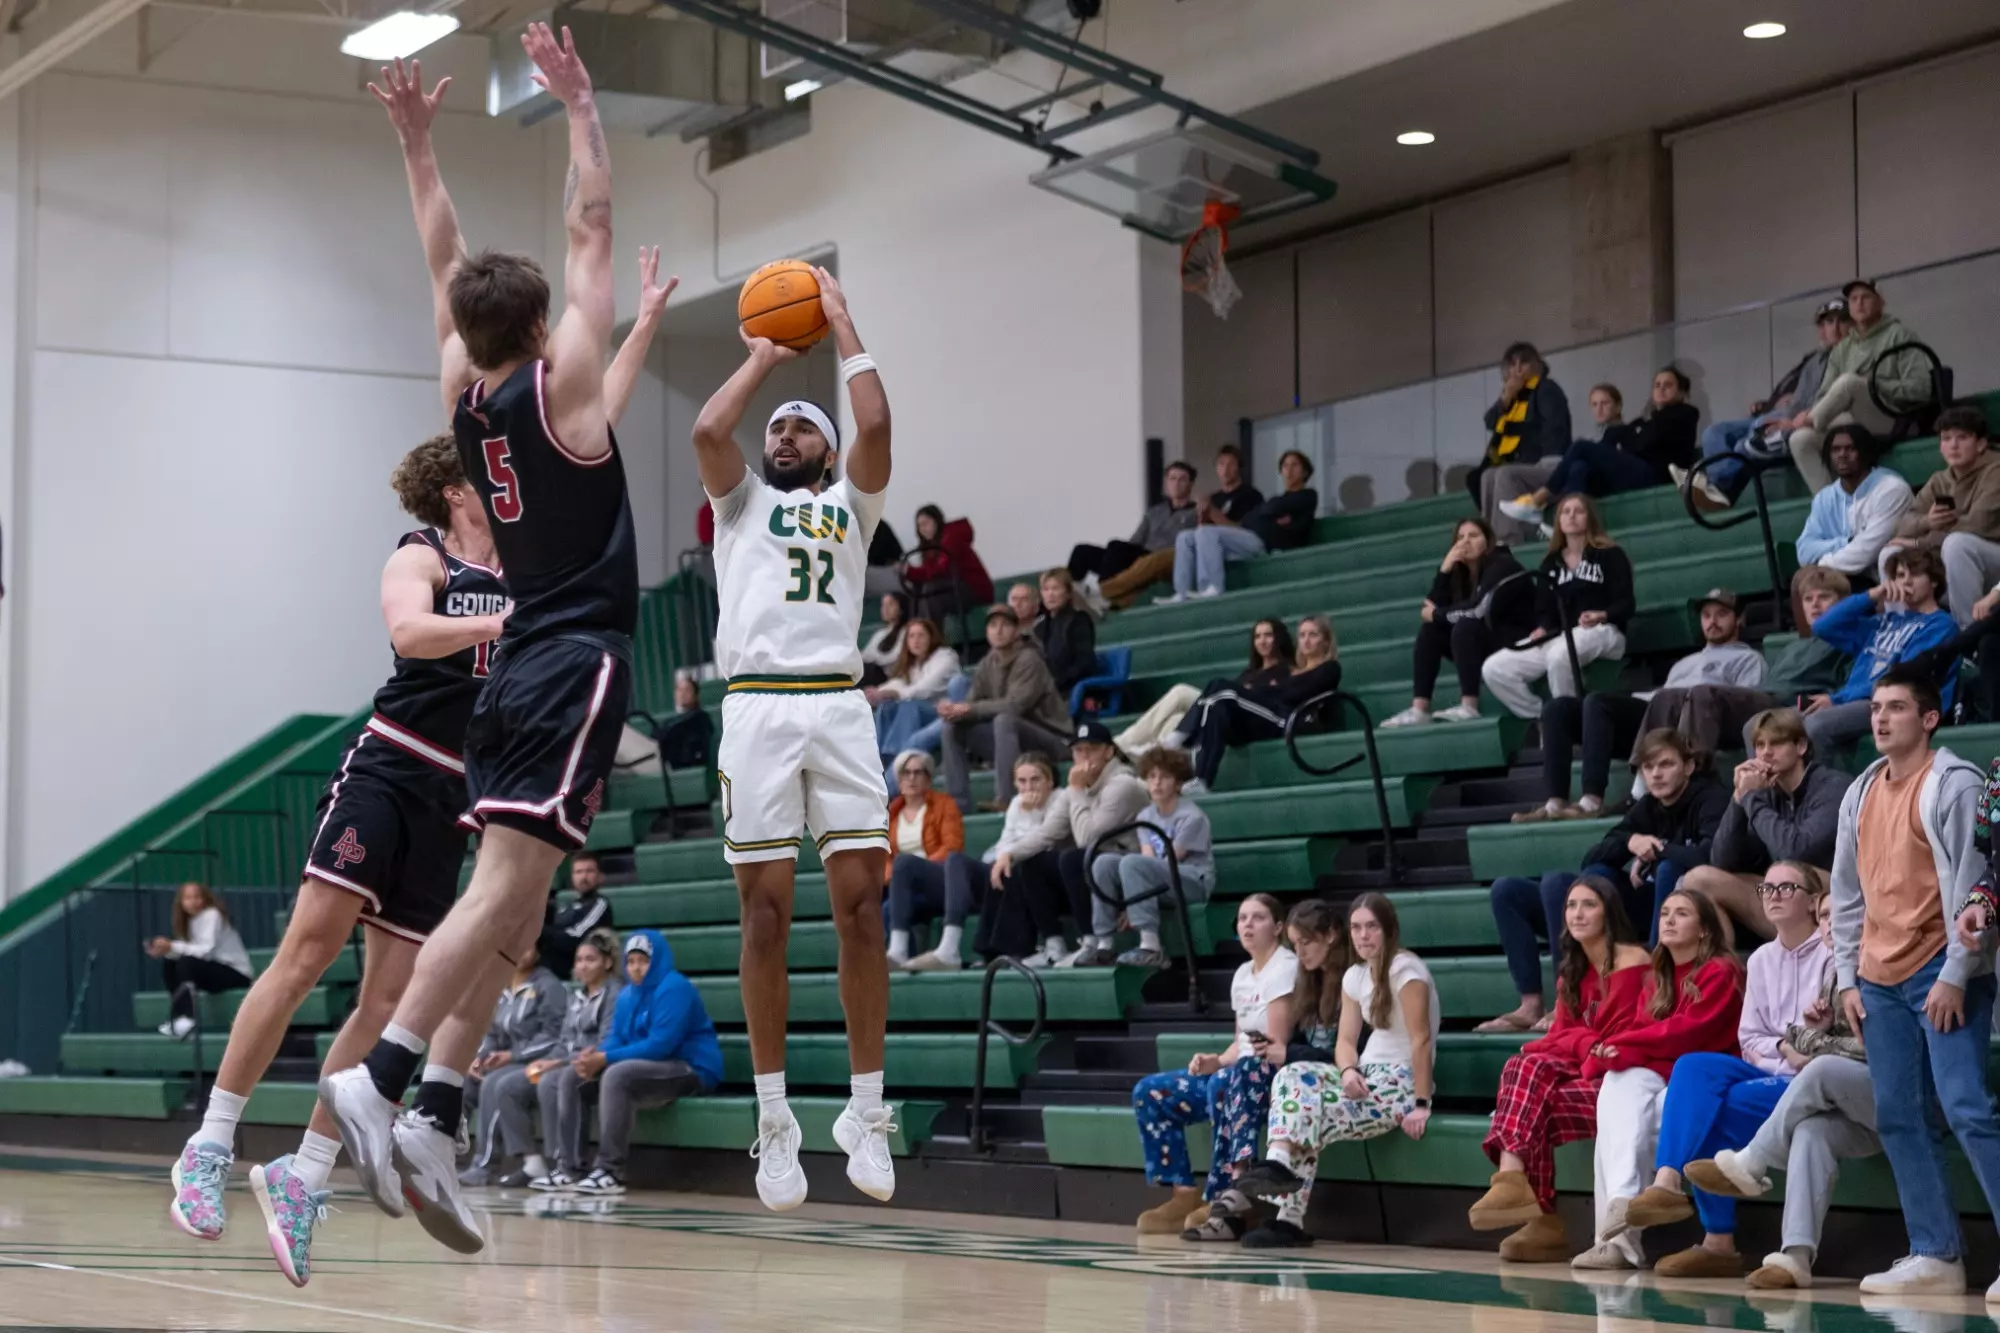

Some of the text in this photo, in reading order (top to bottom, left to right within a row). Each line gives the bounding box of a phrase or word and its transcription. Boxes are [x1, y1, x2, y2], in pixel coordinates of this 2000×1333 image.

[482, 436, 524, 523] 5
[785, 547, 837, 605] 32
[472, 636, 501, 679] 1
[331, 827, 366, 870] AP
